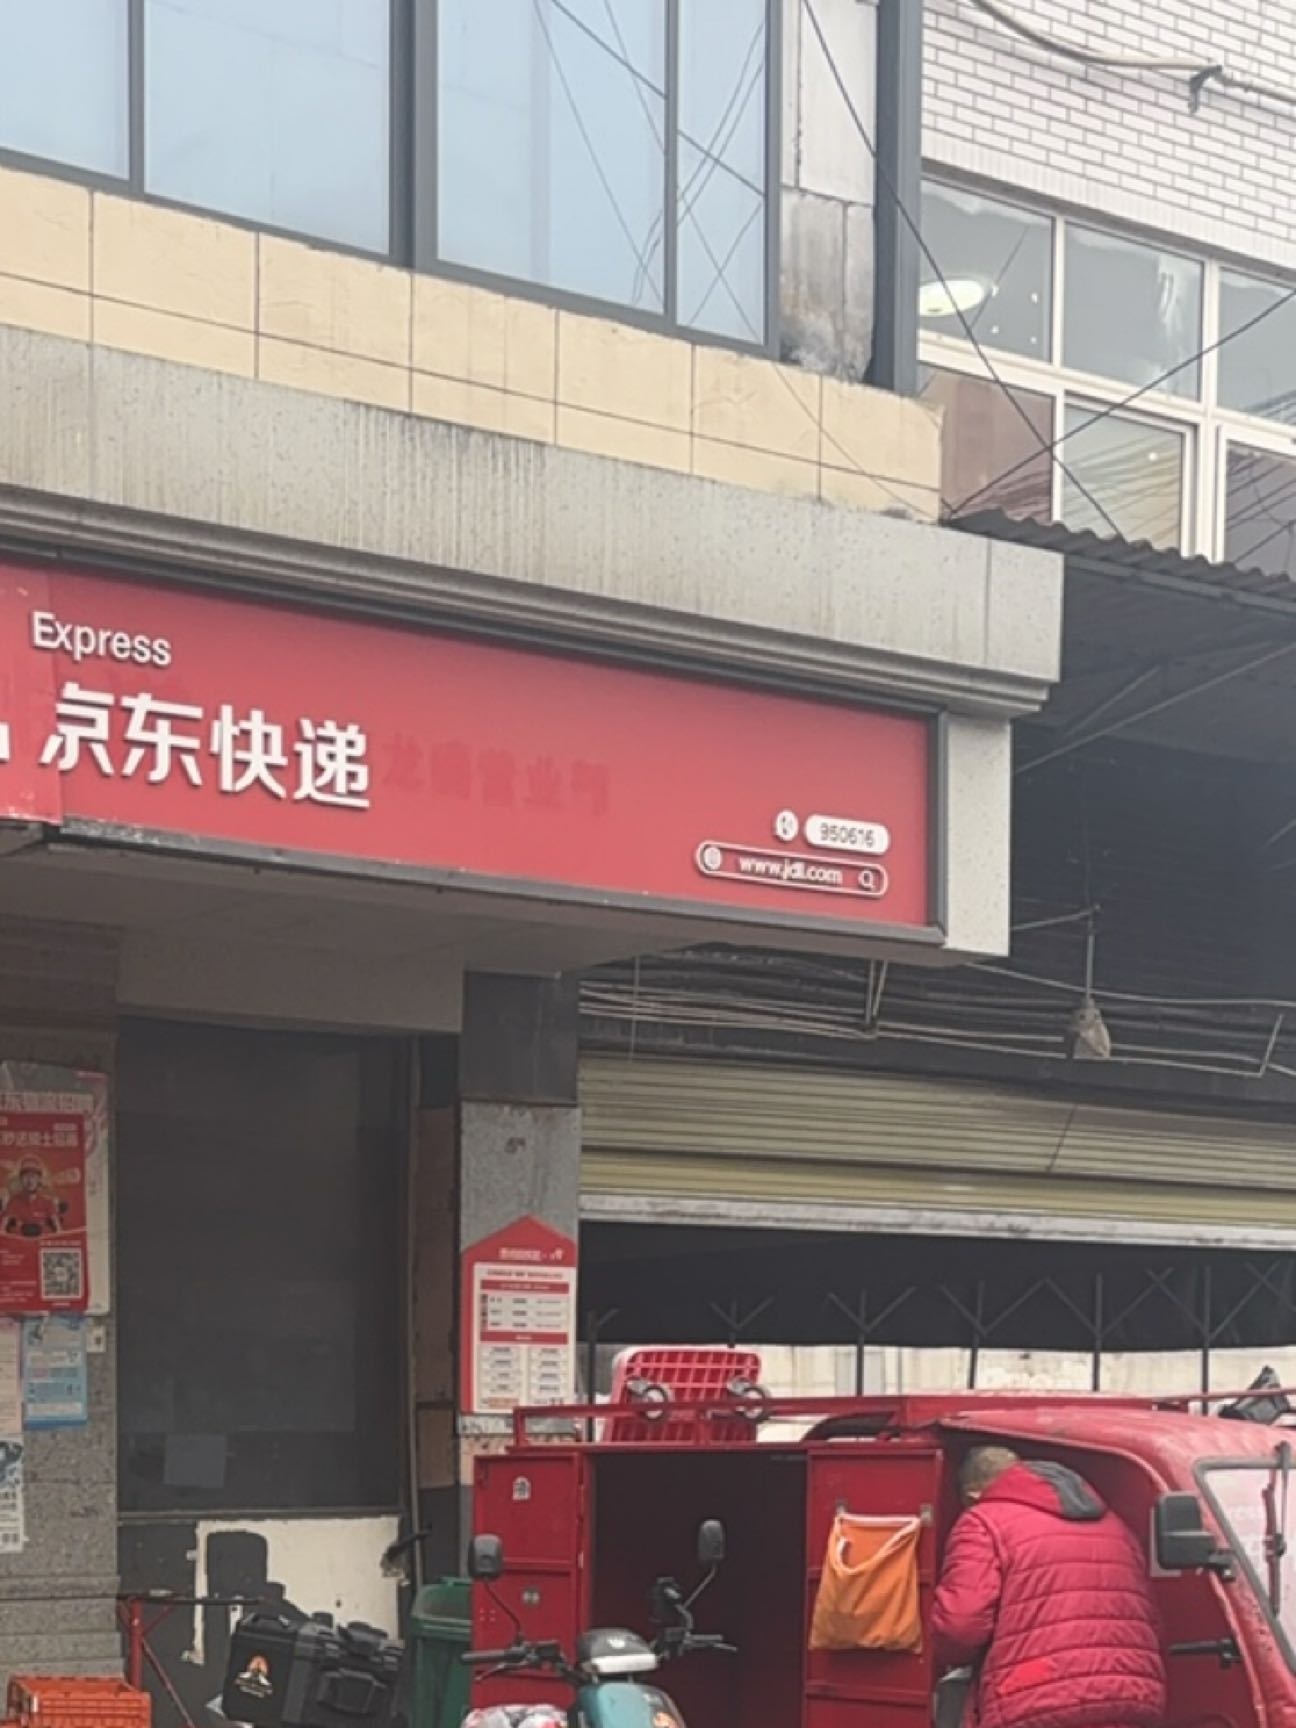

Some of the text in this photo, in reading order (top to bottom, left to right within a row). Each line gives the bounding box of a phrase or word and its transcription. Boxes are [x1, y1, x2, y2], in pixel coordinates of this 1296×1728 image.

[31, 611, 172, 667] Express
[40, 683, 370, 809] 京东快递
[819, 821, 876, 849] 950616
[738, 855, 843, 886] www.jdl.com
